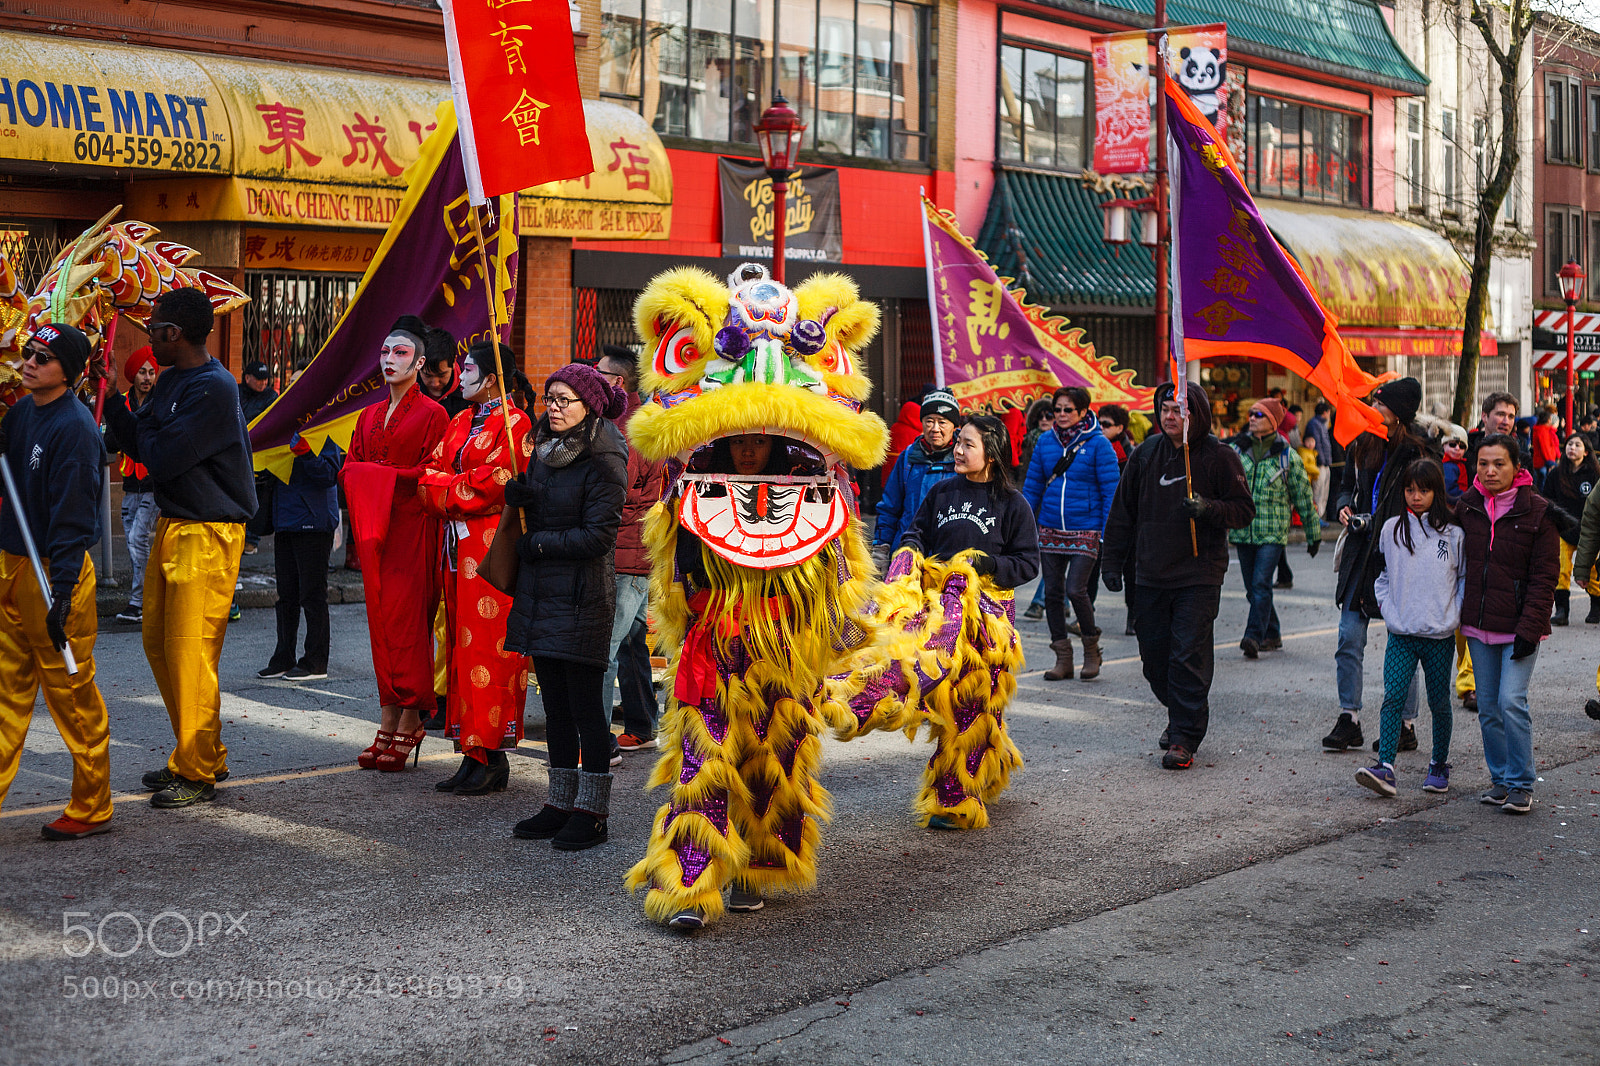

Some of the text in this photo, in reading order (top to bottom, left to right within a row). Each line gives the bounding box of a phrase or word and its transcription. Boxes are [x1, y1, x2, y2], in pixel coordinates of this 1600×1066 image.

[486, 0, 550, 147] 育會
[0, 77, 226, 142] HOME MART Inc.
[74, 132, 222, 171] 604-559-2822
[246, 187, 292, 218] DONG
[295, 191, 350, 222] CHENG
[626, 212, 664, 233] PENDER
[750, 197, 815, 242] Suply
[1383, 307, 1419, 323] HERBAL
